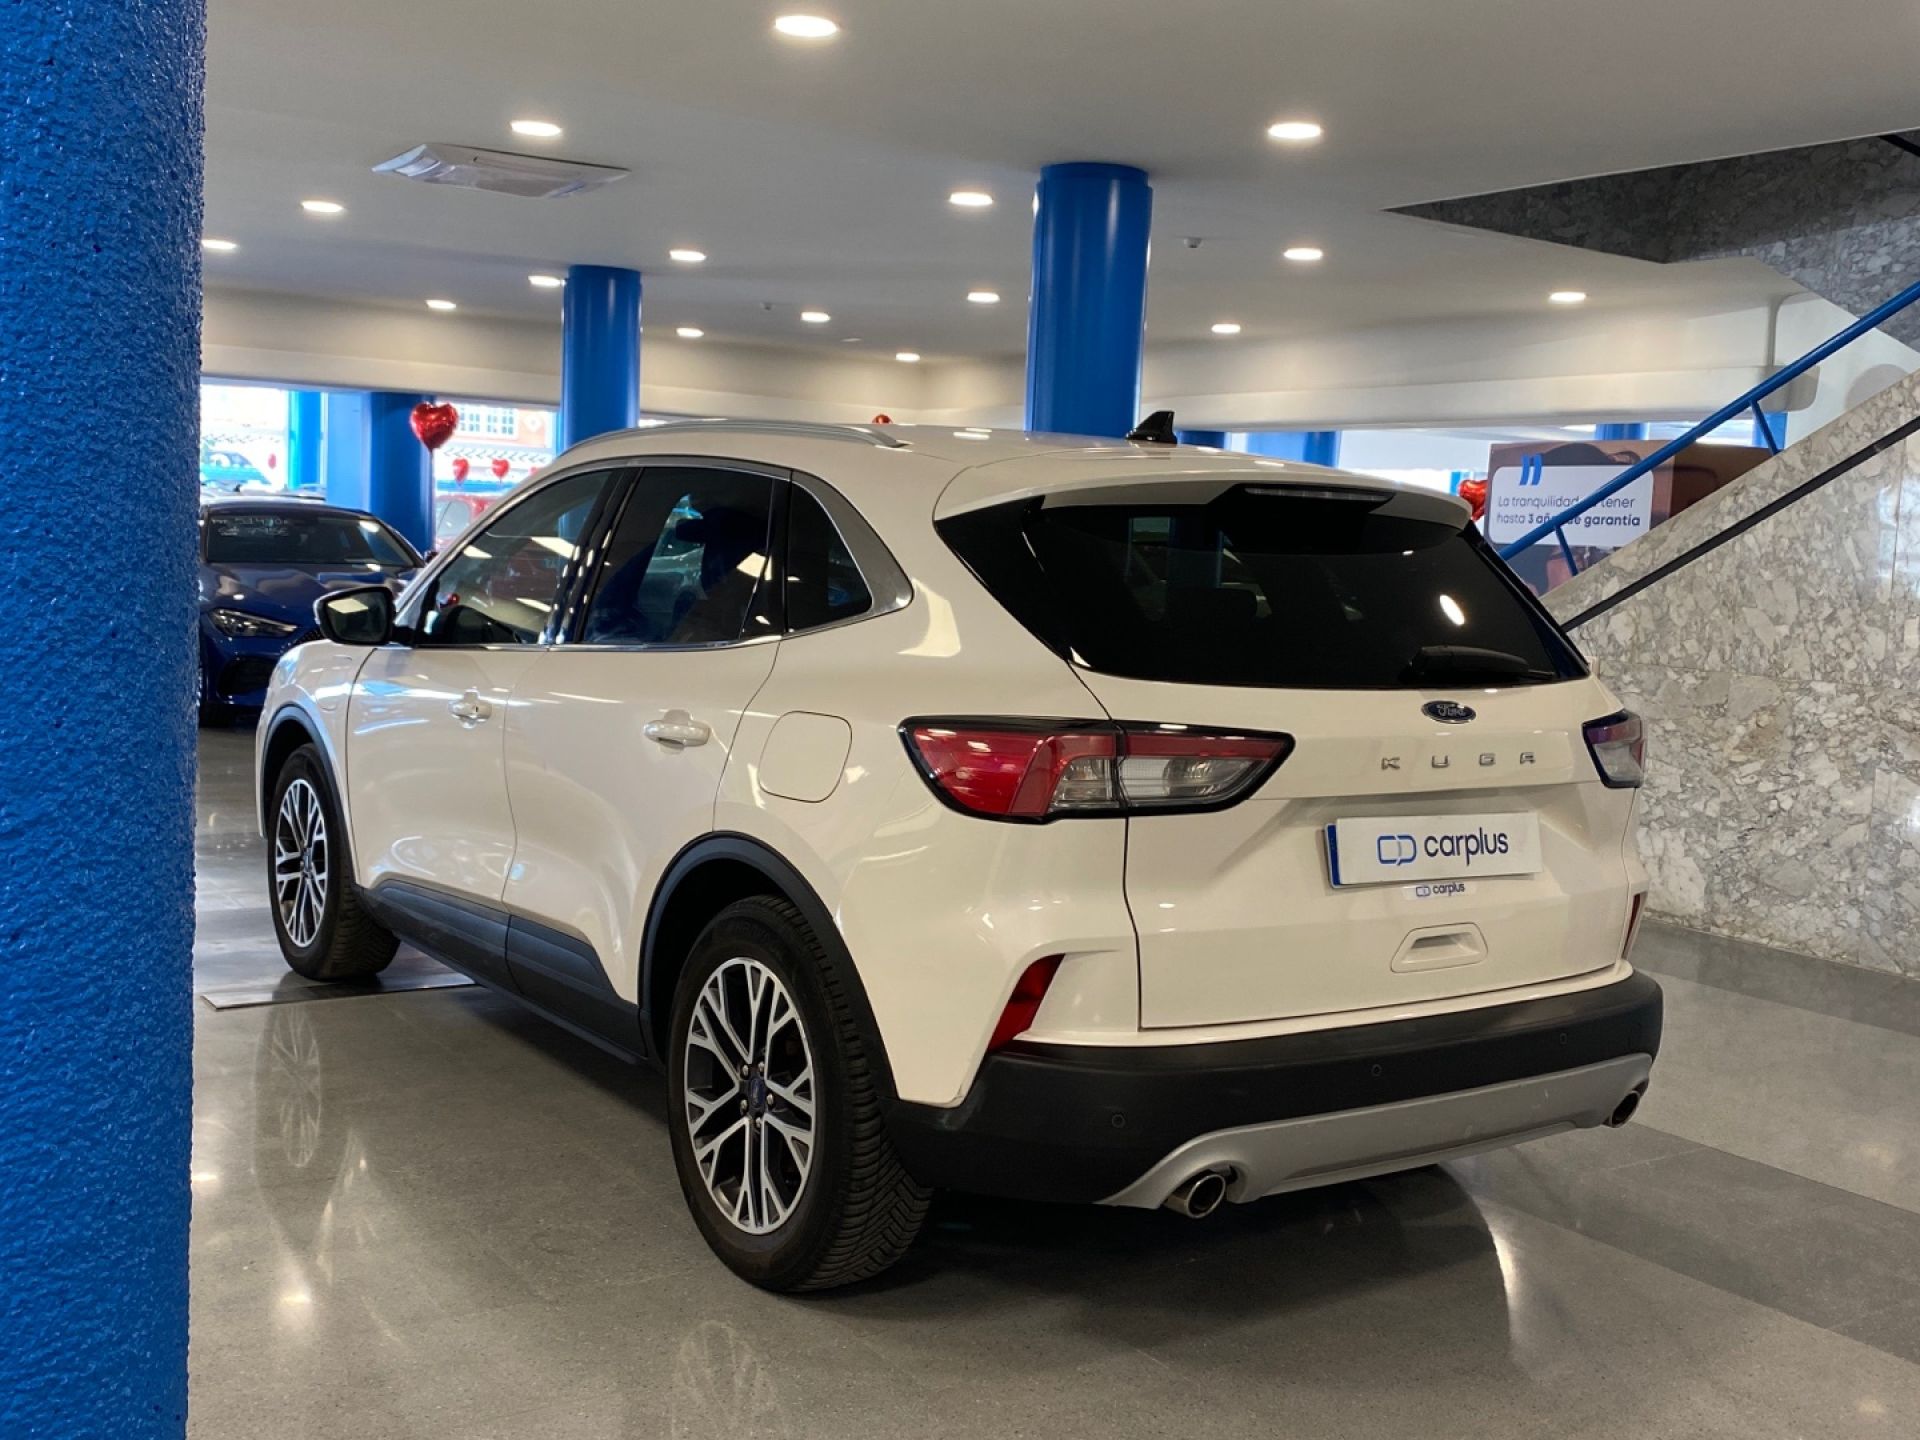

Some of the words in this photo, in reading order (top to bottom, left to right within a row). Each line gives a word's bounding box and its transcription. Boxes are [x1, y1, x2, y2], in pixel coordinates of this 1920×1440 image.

[1497, 495, 1511, 507] La
[1496, 512, 1526, 524] hasta
[1527, 513, 1534, 524] 3
[1584, 513, 1641, 528] garantía
[1380, 751, 1536, 771] KUGA
[1423, 825, 1509, 867] carplus
[1432, 881, 1466, 897] carplus
